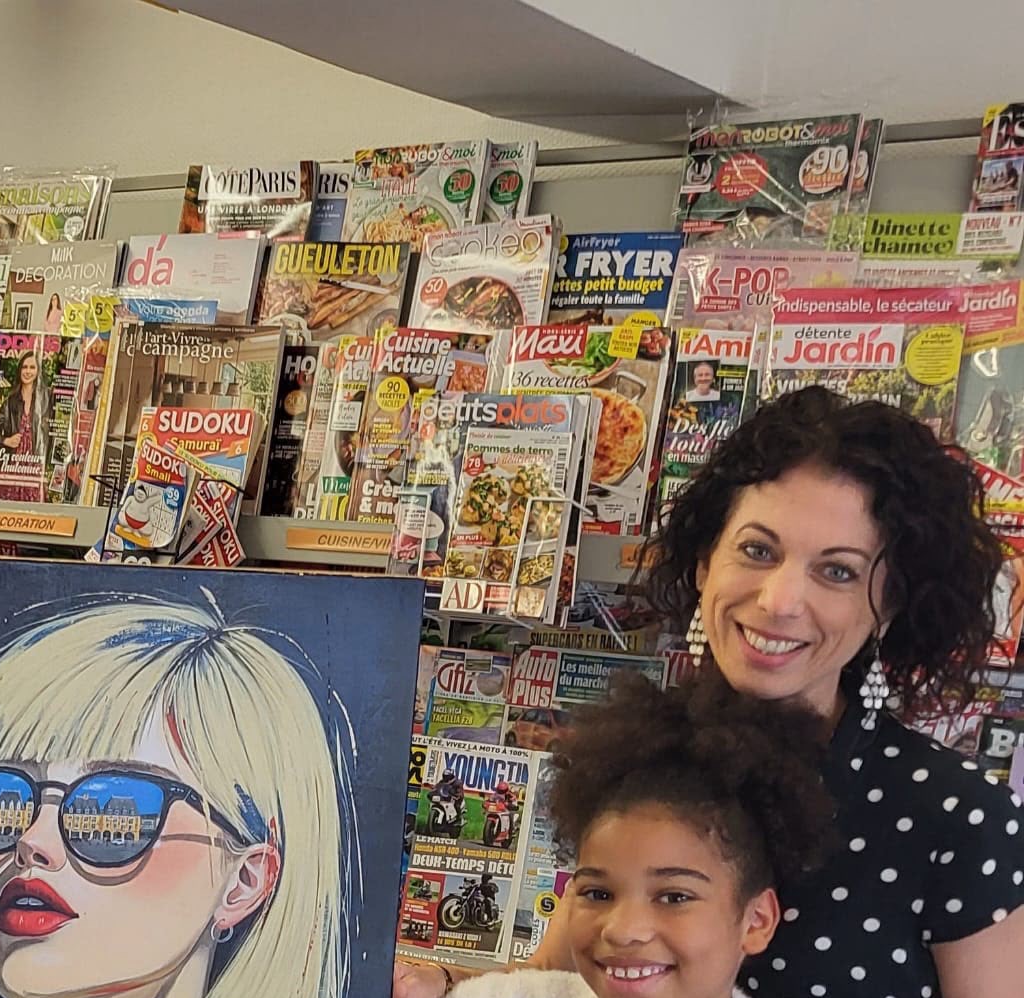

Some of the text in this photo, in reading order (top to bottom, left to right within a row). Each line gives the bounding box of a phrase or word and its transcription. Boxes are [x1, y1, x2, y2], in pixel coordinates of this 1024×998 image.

[871, 219, 951, 236] binette
[573, 236, 621, 249] AirFryer
[275, 244, 401, 276] GUEULETON
[576, 250, 673, 277] FRYER
[424, 278, 442, 293] 50
[584, 276, 664, 293] petit budget
[705, 267, 790, 296] K-POP
[581, 294, 603, 306] toute
[604, 294, 614, 306] la
[615, 294, 645, 306] famille
[877, 296, 953, 312] le sécateur
[171, 332, 204, 345] Vivre
[794, 326, 852, 340] détente
[383, 331, 451, 354] Cuisine
[510, 328, 585, 360] Maxi
[142, 343, 234, 363] campagne
[378, 354, 456, 377] Actuelle
[386, 381, 401, 392] 90
[534, 374, 590, 388] recettes
[378, 392, 406, 400] RECETTES
[142, 419, 149, 431] 6
[158, 410, 251, 436] SUDOKU
[172, 437, 222, 451] Samuraï
[513, 445, 523, 454] de
[468, 458, 481, 469] 78
[144, 464, 172, 483] Small
[444, 581, 483, 610] AD
[530, 632, 598, 649] SUPERCARS EN
[560, 659, 577, 673] Les
[559, 674, 572, 688] du
[423, 736, 444, 748] L'ÉTÉ,
[446, 740, 467, 750] VIVEZ
[467, 743, 478, 751] LA
[479, 745, 501, 754] MOTO
[509, 749, 529, 758] 100%
[426, 836, 457, 846] MATCH
[412, 854, 486, 873] DEUX-TEMPS
